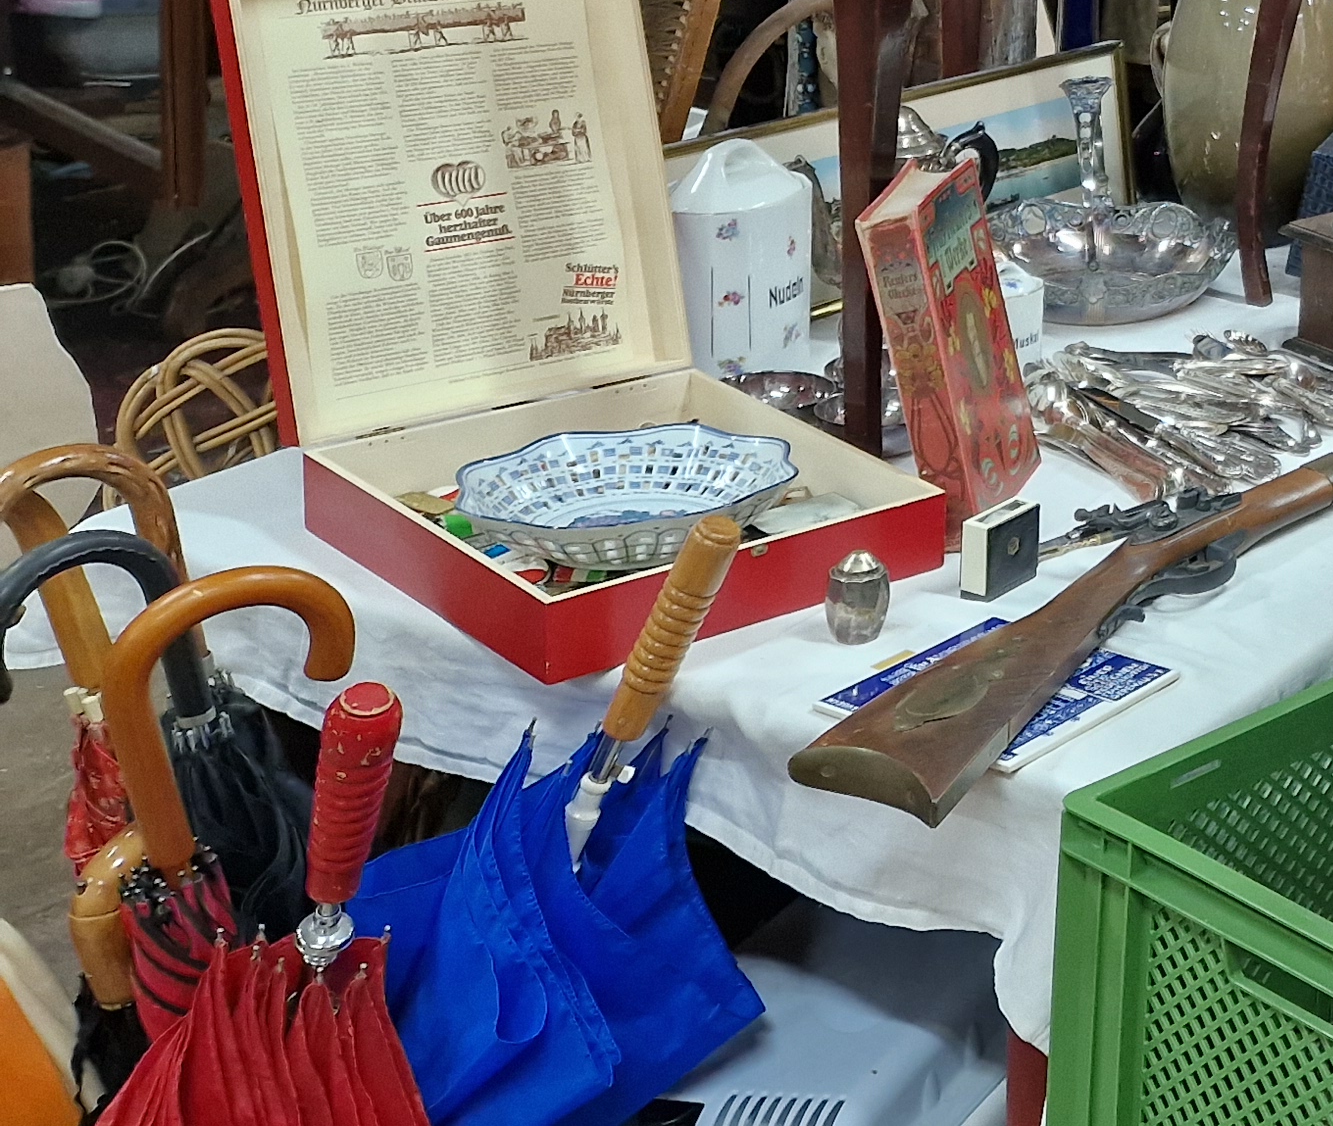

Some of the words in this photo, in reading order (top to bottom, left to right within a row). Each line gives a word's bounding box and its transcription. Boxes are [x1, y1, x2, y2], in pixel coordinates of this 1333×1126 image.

[424, 211, 452, 224] Über
[455, 208, 473, 219] 600
[474, 205, 505, 218] Jahre
[438, 217, 498, 234] herzhafter
[574, 273, 618, 287] Echte!
